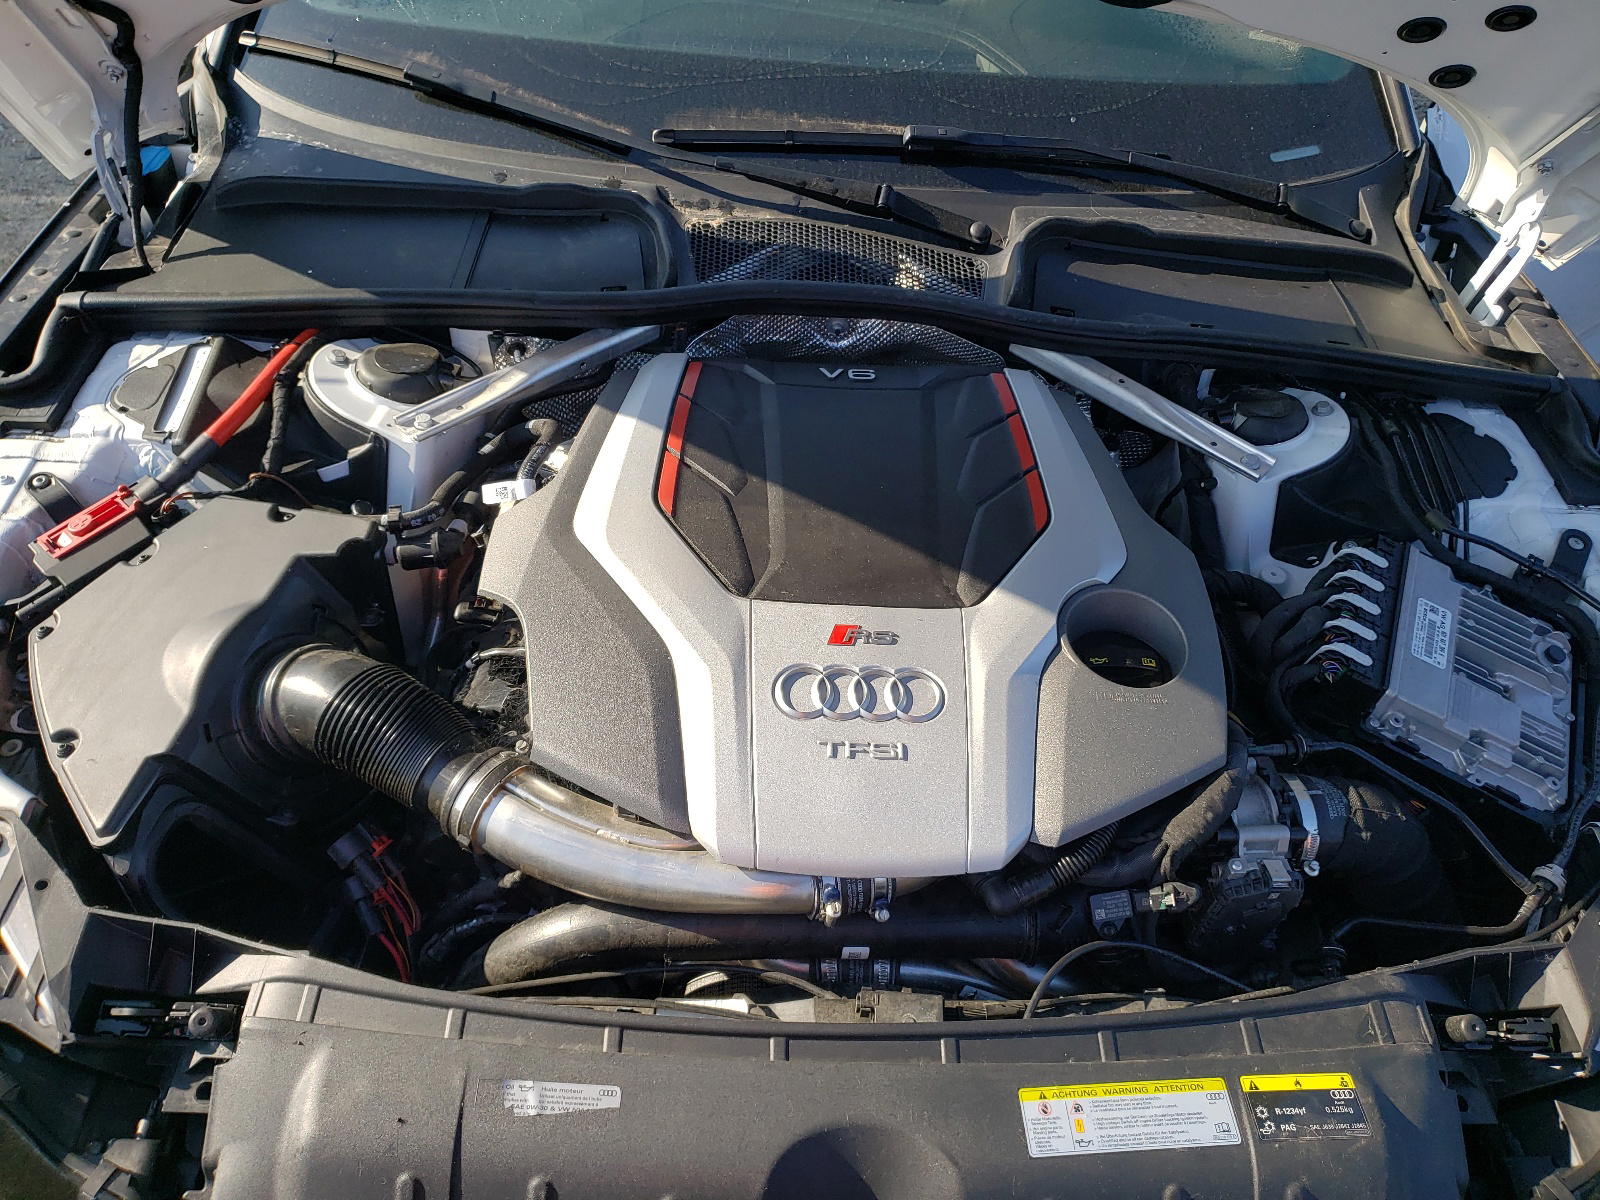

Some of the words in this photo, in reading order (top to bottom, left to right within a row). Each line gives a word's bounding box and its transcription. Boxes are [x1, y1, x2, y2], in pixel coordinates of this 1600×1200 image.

[818, 367, 877, 380] V6
[837, 627, 898, 645] RS
[817, 741, 907, 760] TFSI
[1052, 1089, 1098, 1099] ACHTUNG
[1102, 1086, 1149, 1096] WARNING
[1154, 1083, 1204, 1093] ATTENTION
[1274, 1107, 1307, 1116] R-1234yf
[1324, 1106, 1354, 1114] 0.525kg
[1280, 1124, 1297, 1132] PAG
